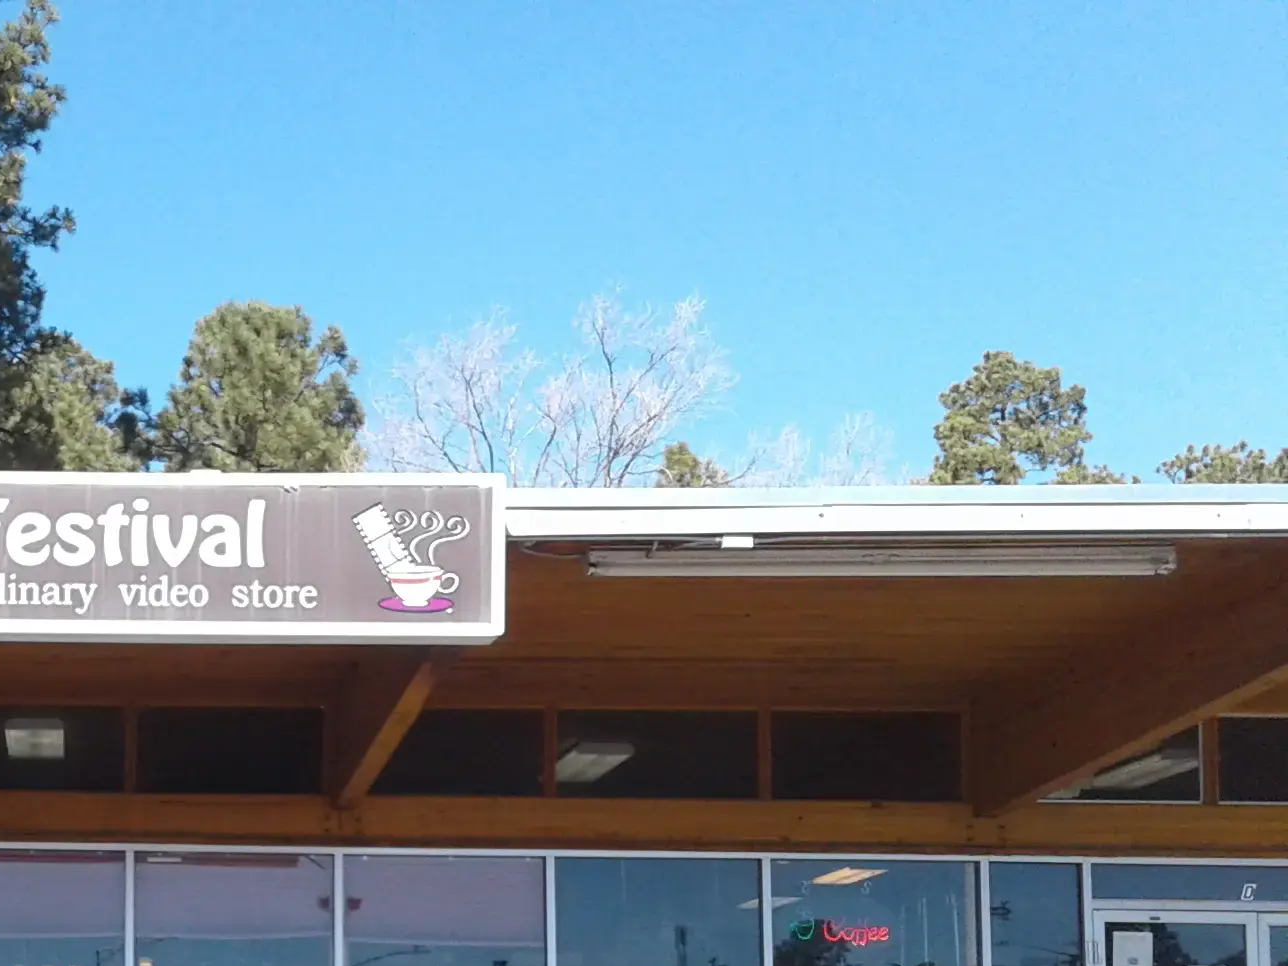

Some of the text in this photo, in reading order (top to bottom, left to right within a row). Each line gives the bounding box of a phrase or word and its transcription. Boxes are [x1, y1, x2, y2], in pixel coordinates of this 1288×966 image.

[117, 574, 209, 609] video
[231, 578, 318, 610] store
[823, 918, 890, 946] Coffee
